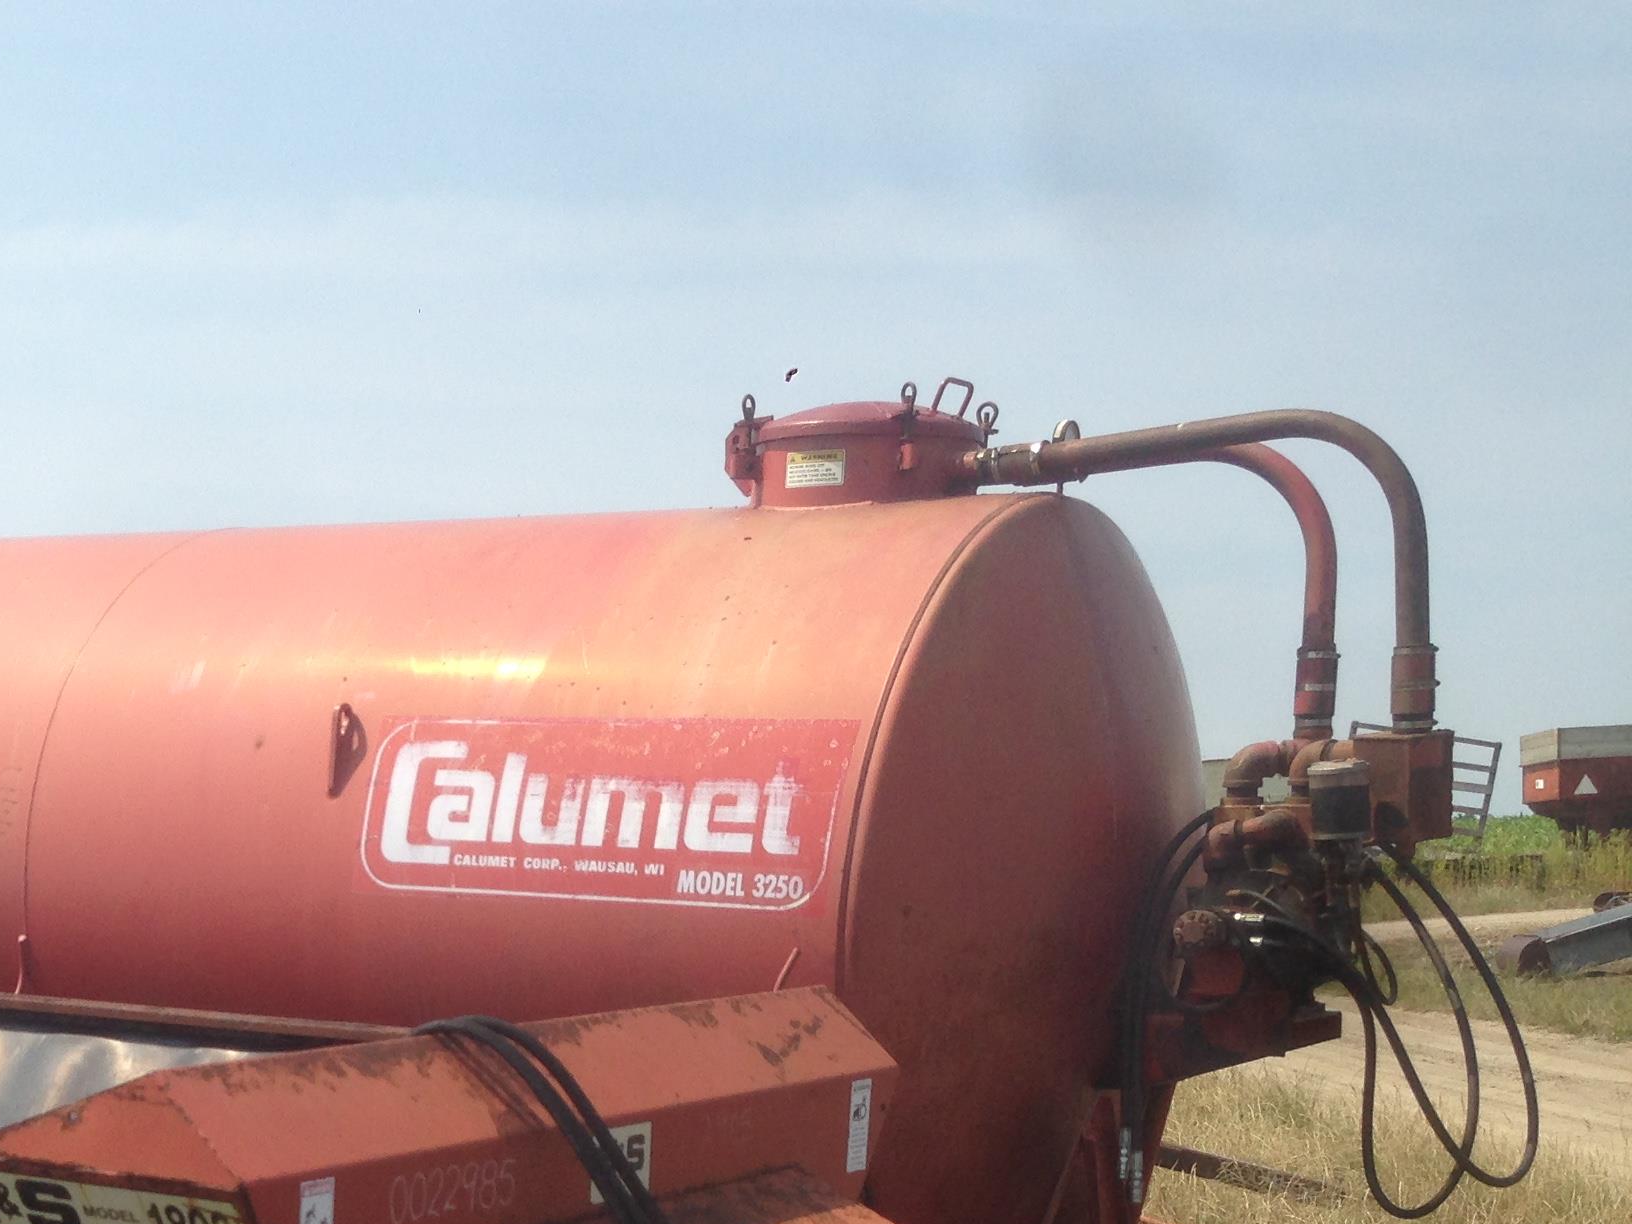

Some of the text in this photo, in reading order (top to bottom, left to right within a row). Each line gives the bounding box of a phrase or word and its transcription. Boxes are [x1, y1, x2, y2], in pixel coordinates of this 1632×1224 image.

[380, 740, 802, 865] Calumet
[453, 854, 516, 868] CALUMET
[574, 860, 638, 876] WAUSAU,
[644, 864, 665, 876] WI
[676, 869, 804, 900] MODEL 3250
[83, 1205, 140, 1224] MODEL
